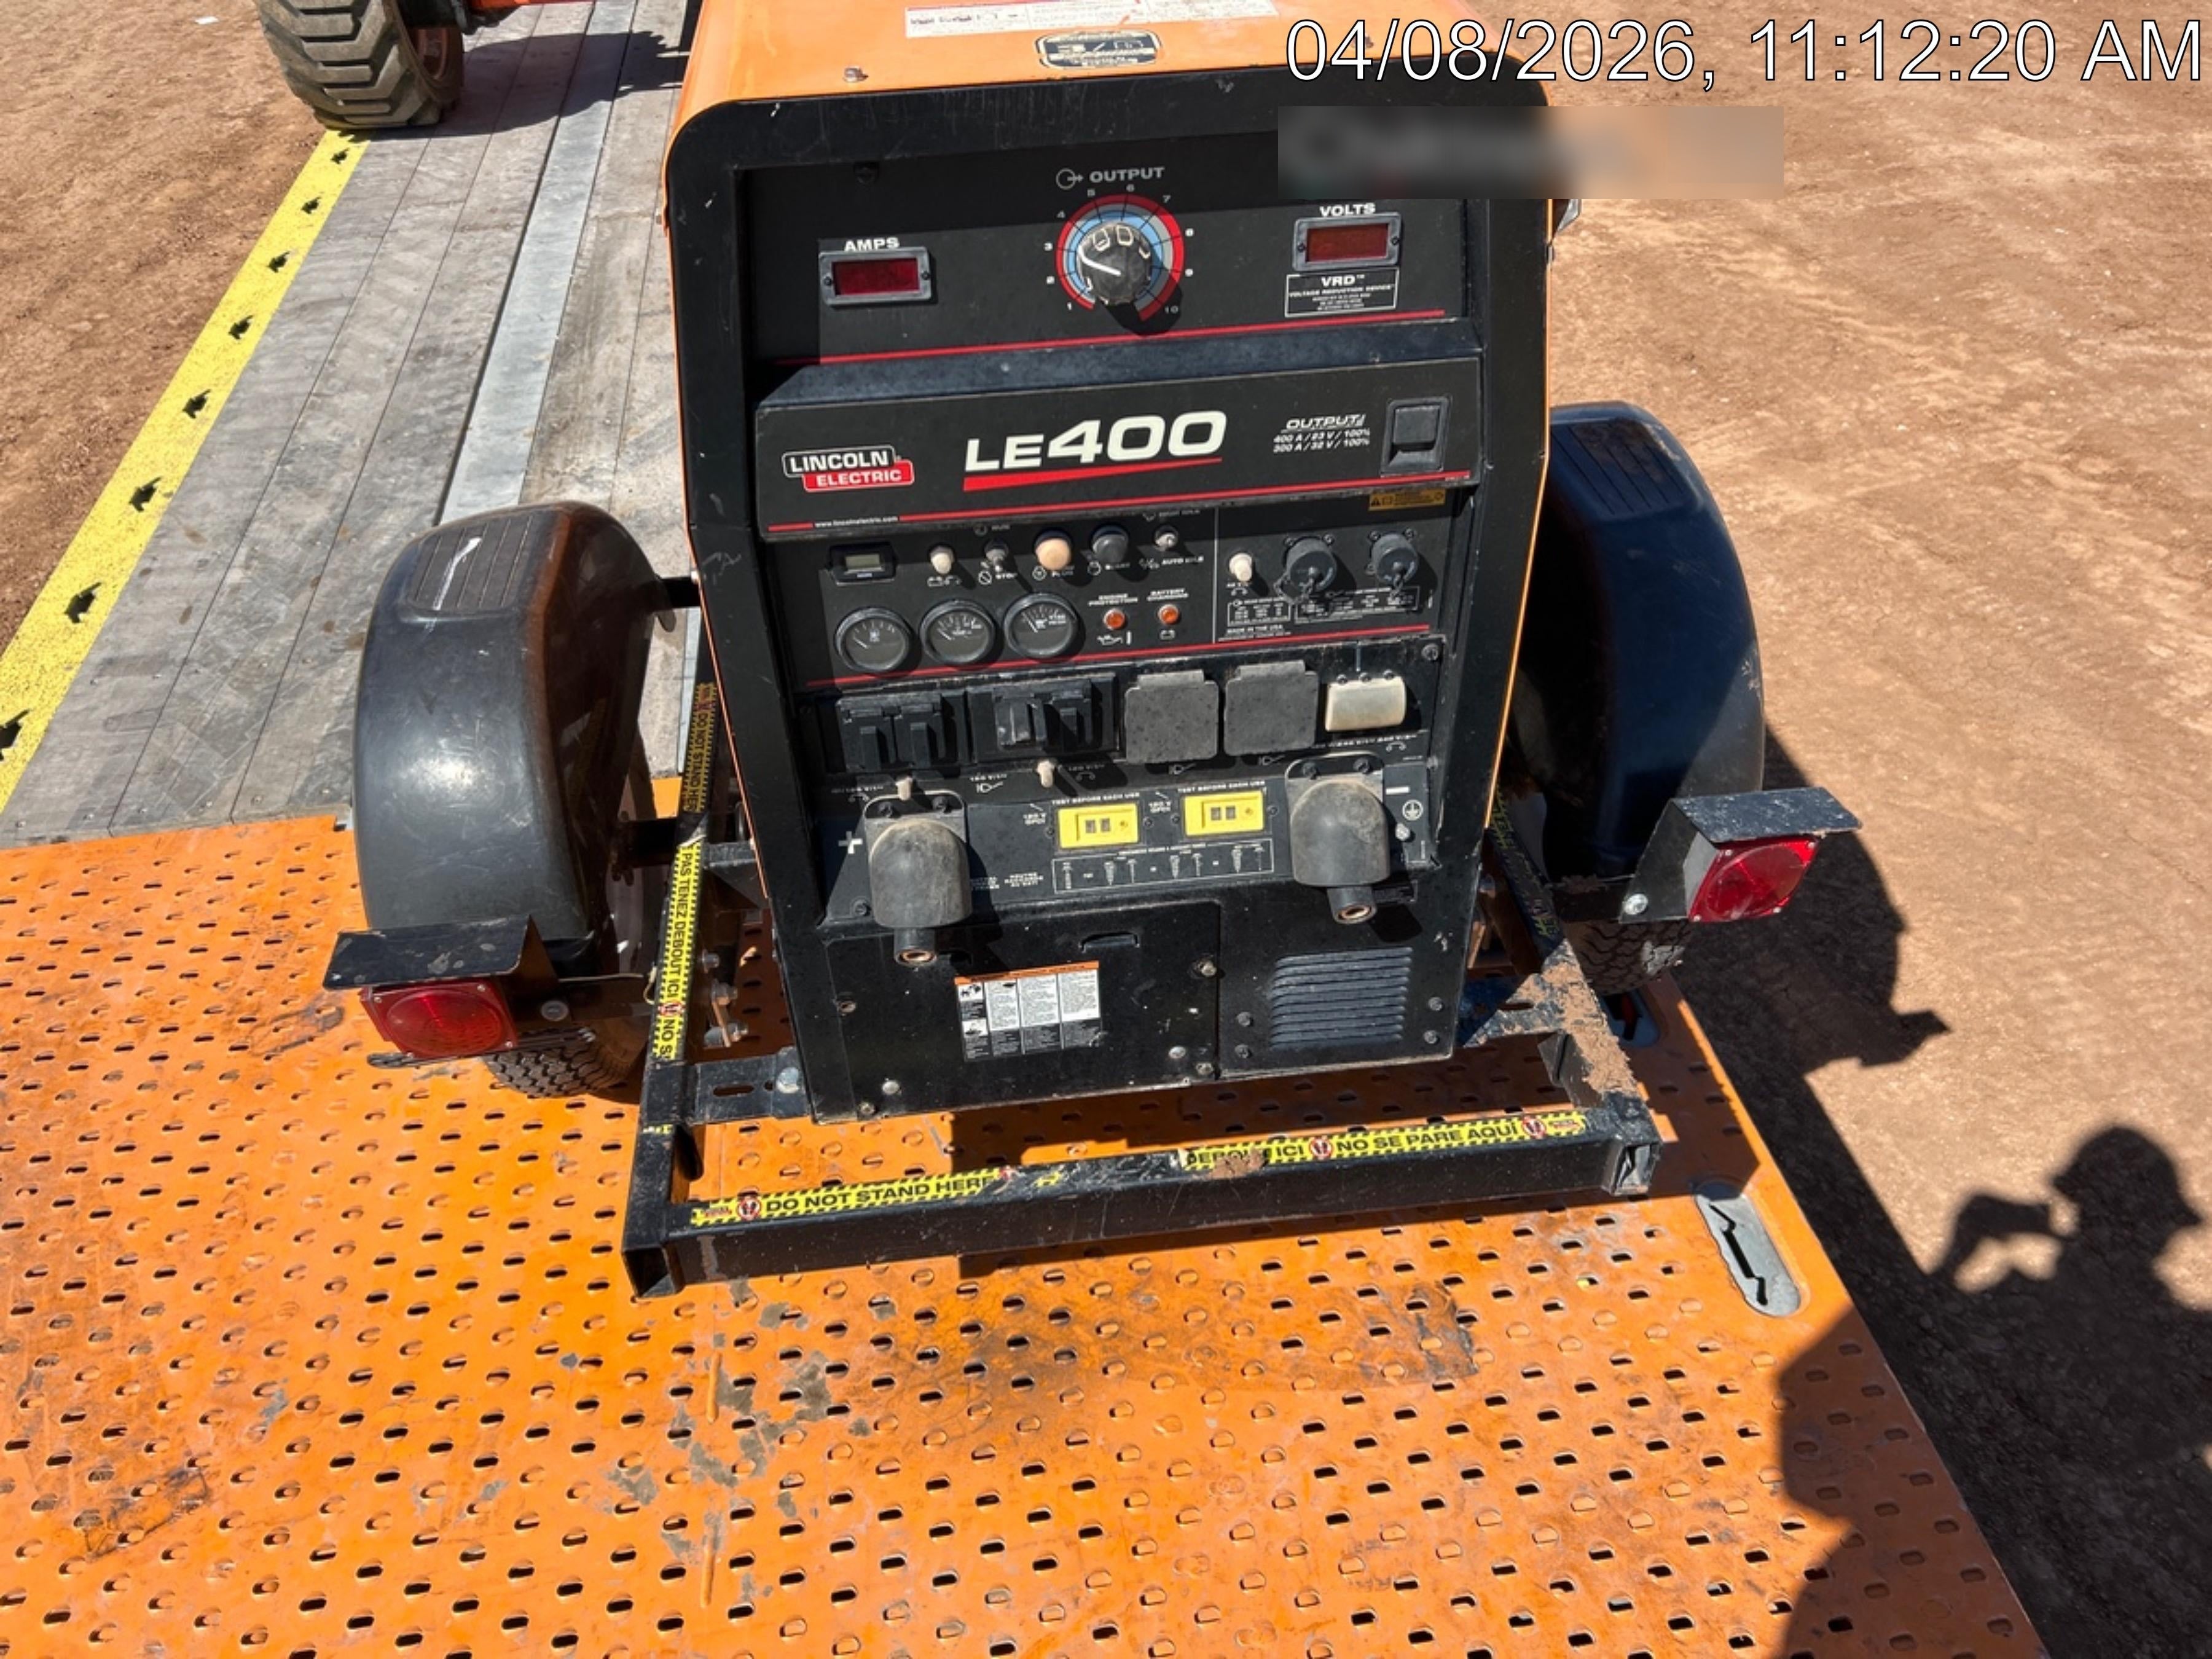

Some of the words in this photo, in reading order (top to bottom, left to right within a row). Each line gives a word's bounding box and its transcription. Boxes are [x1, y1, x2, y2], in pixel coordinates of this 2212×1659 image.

[1089, 167, 1164, 183] OUTPUT
[1319, 203, 1376, 216] VOLTS
[844, 237, 900, 251] AMPS
[965, 410, 1227, 472] LE400
[790, 450, 888, 473] LINCOLN
[816, 469, 902, 487] ELECTRIC
[680, 853, 693, 876] PAS
[676, 879, 690, 919] TENEZ
[669, 922, 686, 976] DEBOUT
[667, 978, 680, 997] ICI
[662, 1019, 675, 1041] NO
[1277, 1145, 1304, 1156] ICI
[1336, 1140, 1369, 1152] NO
[1373, 1136, 1401, 1150] SE
[1406, 1129, 1463, 1147] PARE
[767, 1199, 799, 1212] DO
[805, 1193, 852, 1209] NOT
[857, 1183, 930, 1203] STAND
